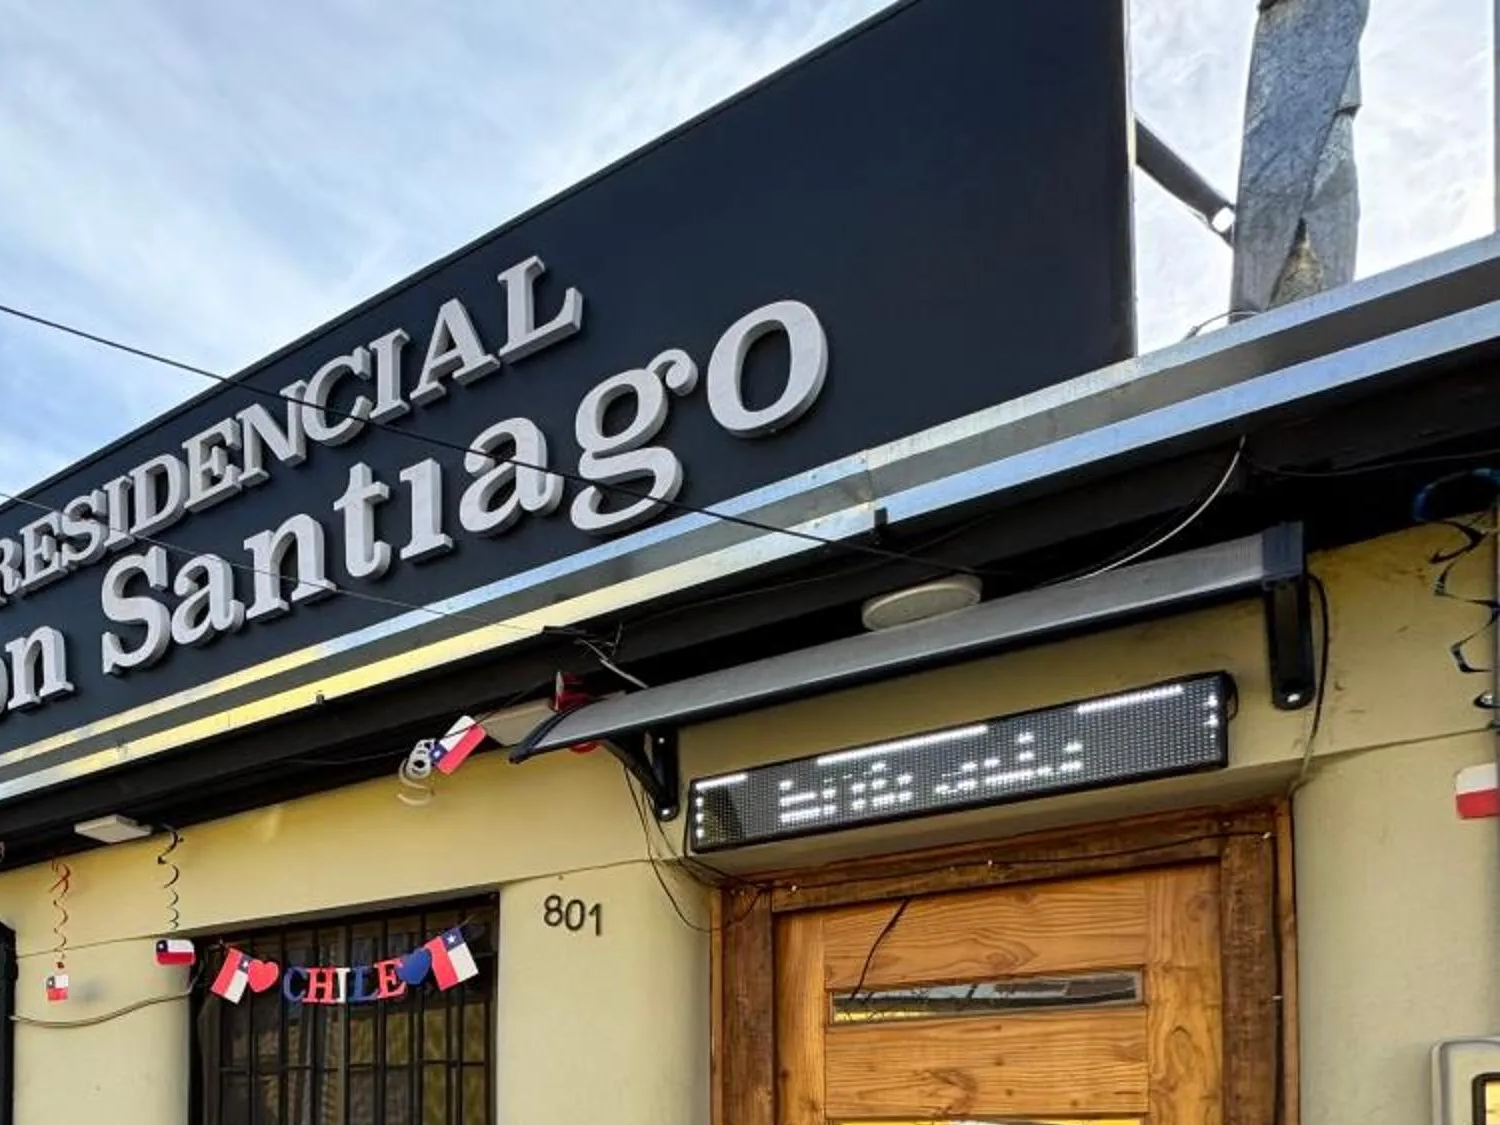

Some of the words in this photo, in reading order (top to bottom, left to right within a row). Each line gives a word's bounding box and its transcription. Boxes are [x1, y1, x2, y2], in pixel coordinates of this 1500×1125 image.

[100, 299, 830, 676] Santiago
[543, 894, 603, 937] 801
[282, 956, 407, 1005] CHILE
